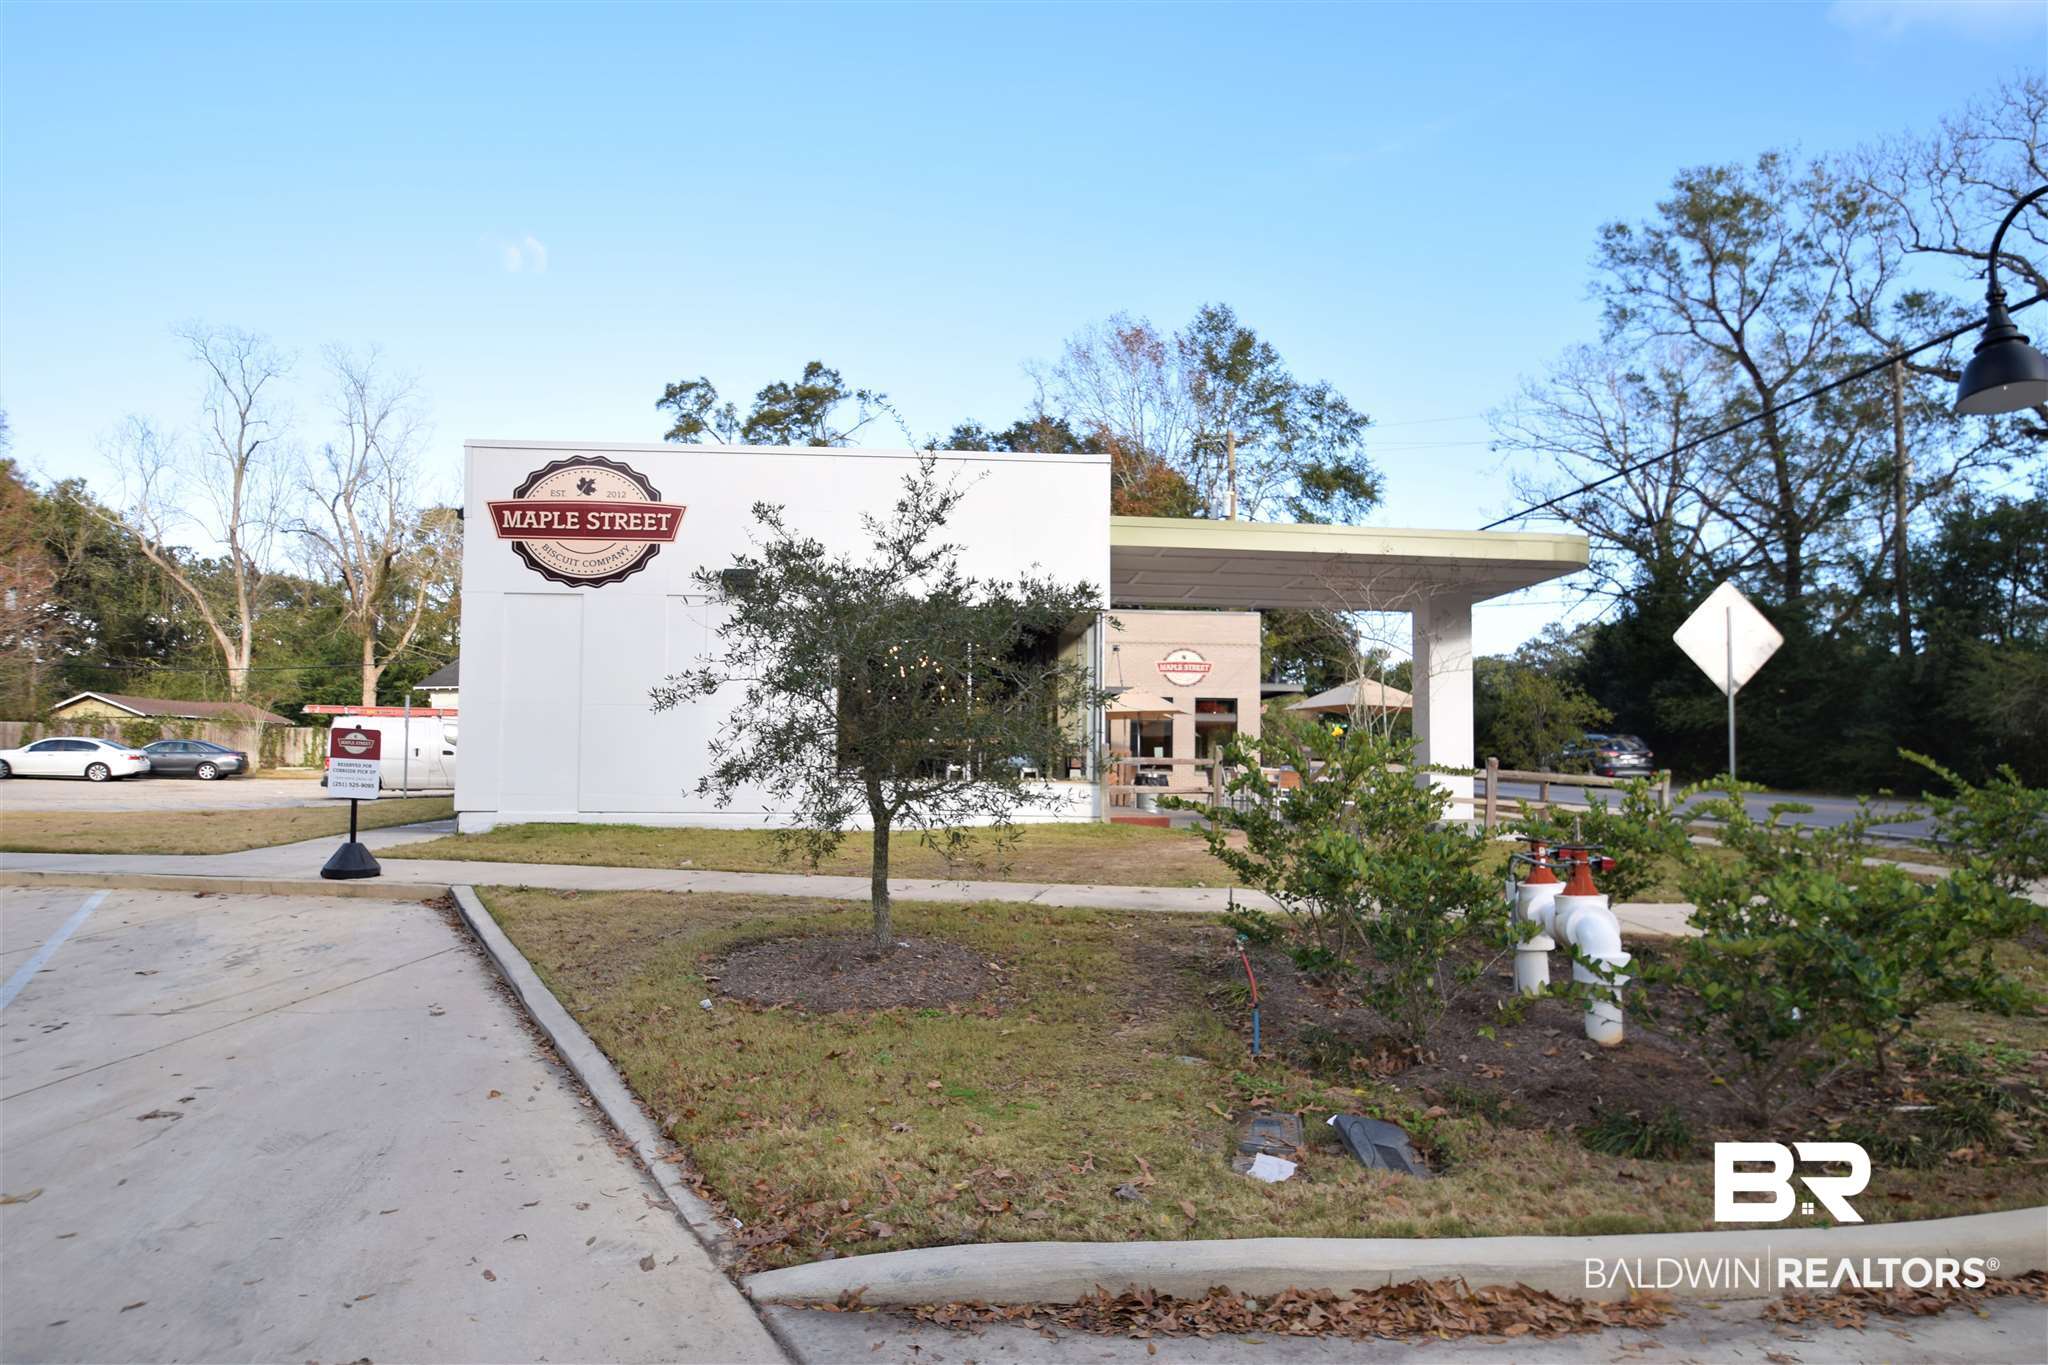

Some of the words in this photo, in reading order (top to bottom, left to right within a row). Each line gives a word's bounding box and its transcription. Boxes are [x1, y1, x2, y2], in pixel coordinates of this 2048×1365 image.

[606, 490, 626, 499] 2012
[502, 510, 580, 529] MAPLE
[586, 511, 671, 531] STREET
[542, 543, 579, 567] BISCUIT
[582, 544, 630, 568] COMPANY
